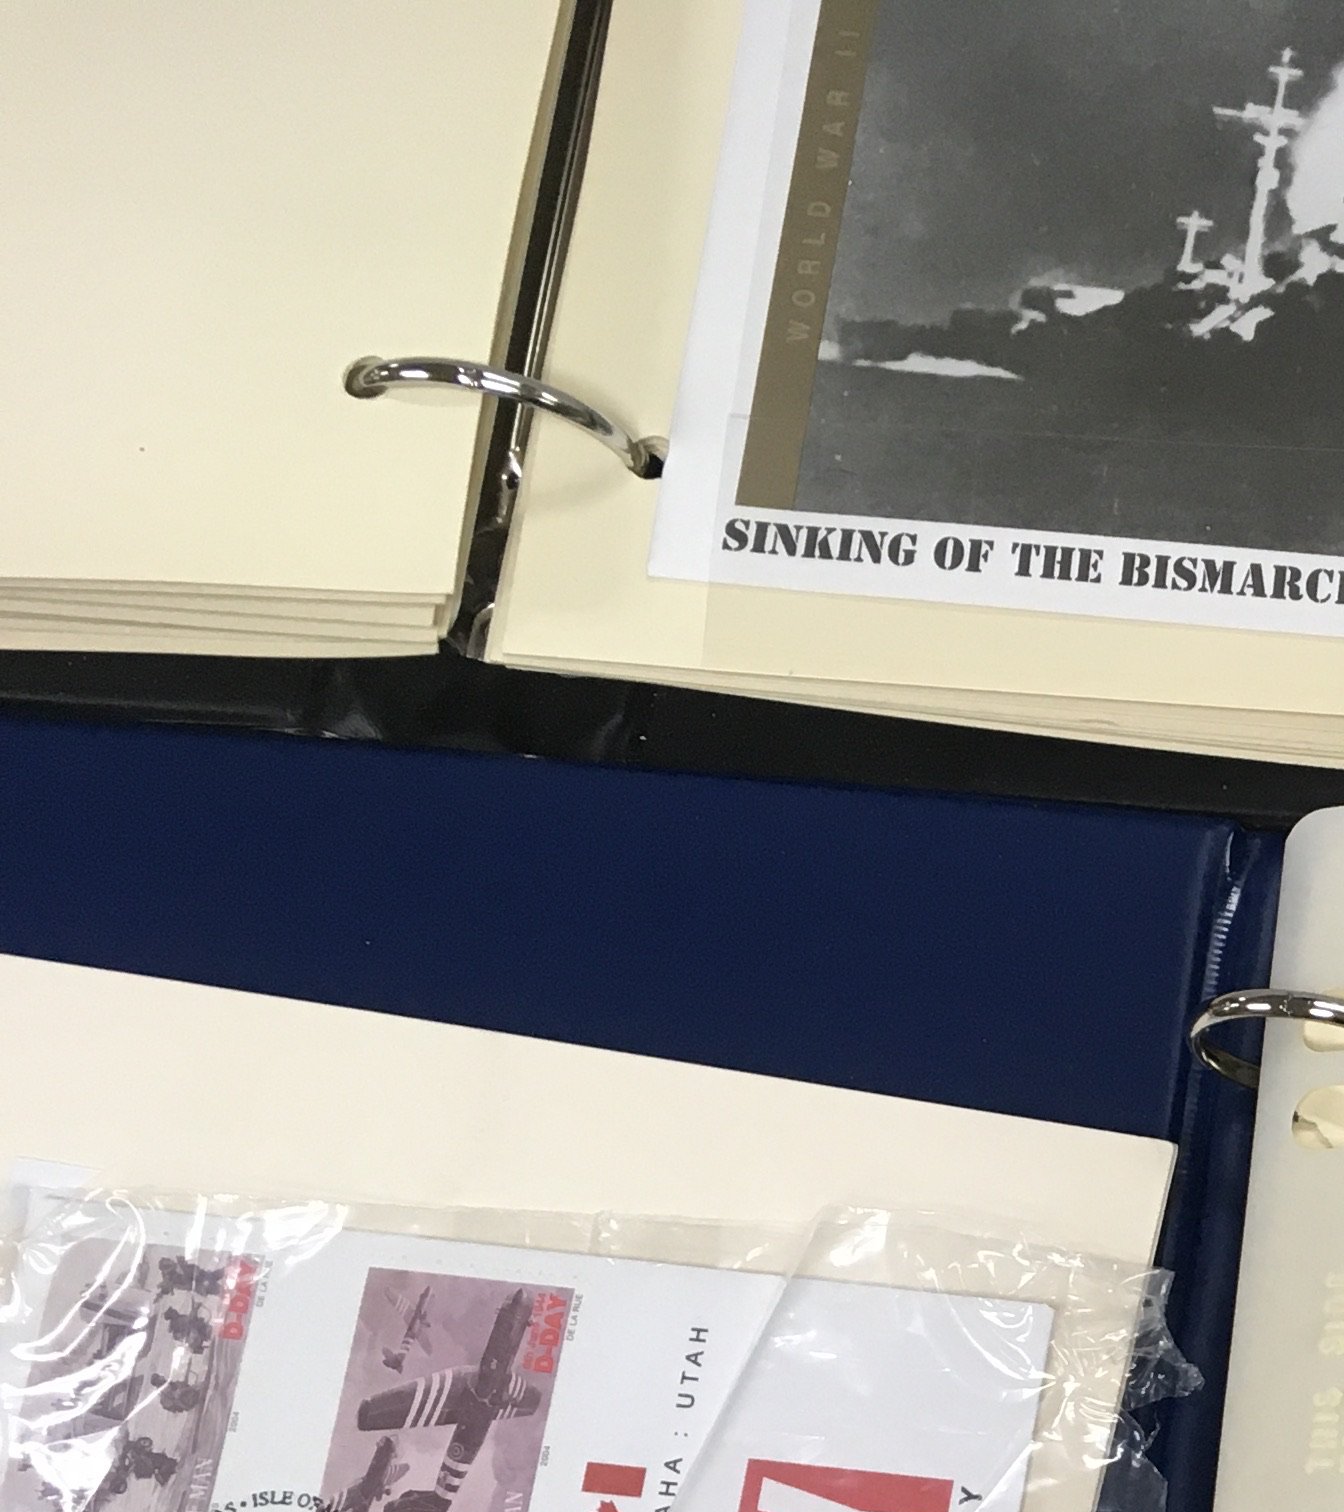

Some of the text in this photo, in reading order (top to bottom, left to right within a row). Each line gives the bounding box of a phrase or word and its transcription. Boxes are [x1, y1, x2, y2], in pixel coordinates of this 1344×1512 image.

[786, 90, 850, 345] WORLD WAR
[722, 517, 918, 568] SINKING
[933, 536, 994, 574] OF
[1011, 542, 1103, 585] THE
[534, 1293, 567, 1373] D-DAY
[676, 1326, 708, 1410] UTAH
[252, 1490, 293, 1507] ISLE
